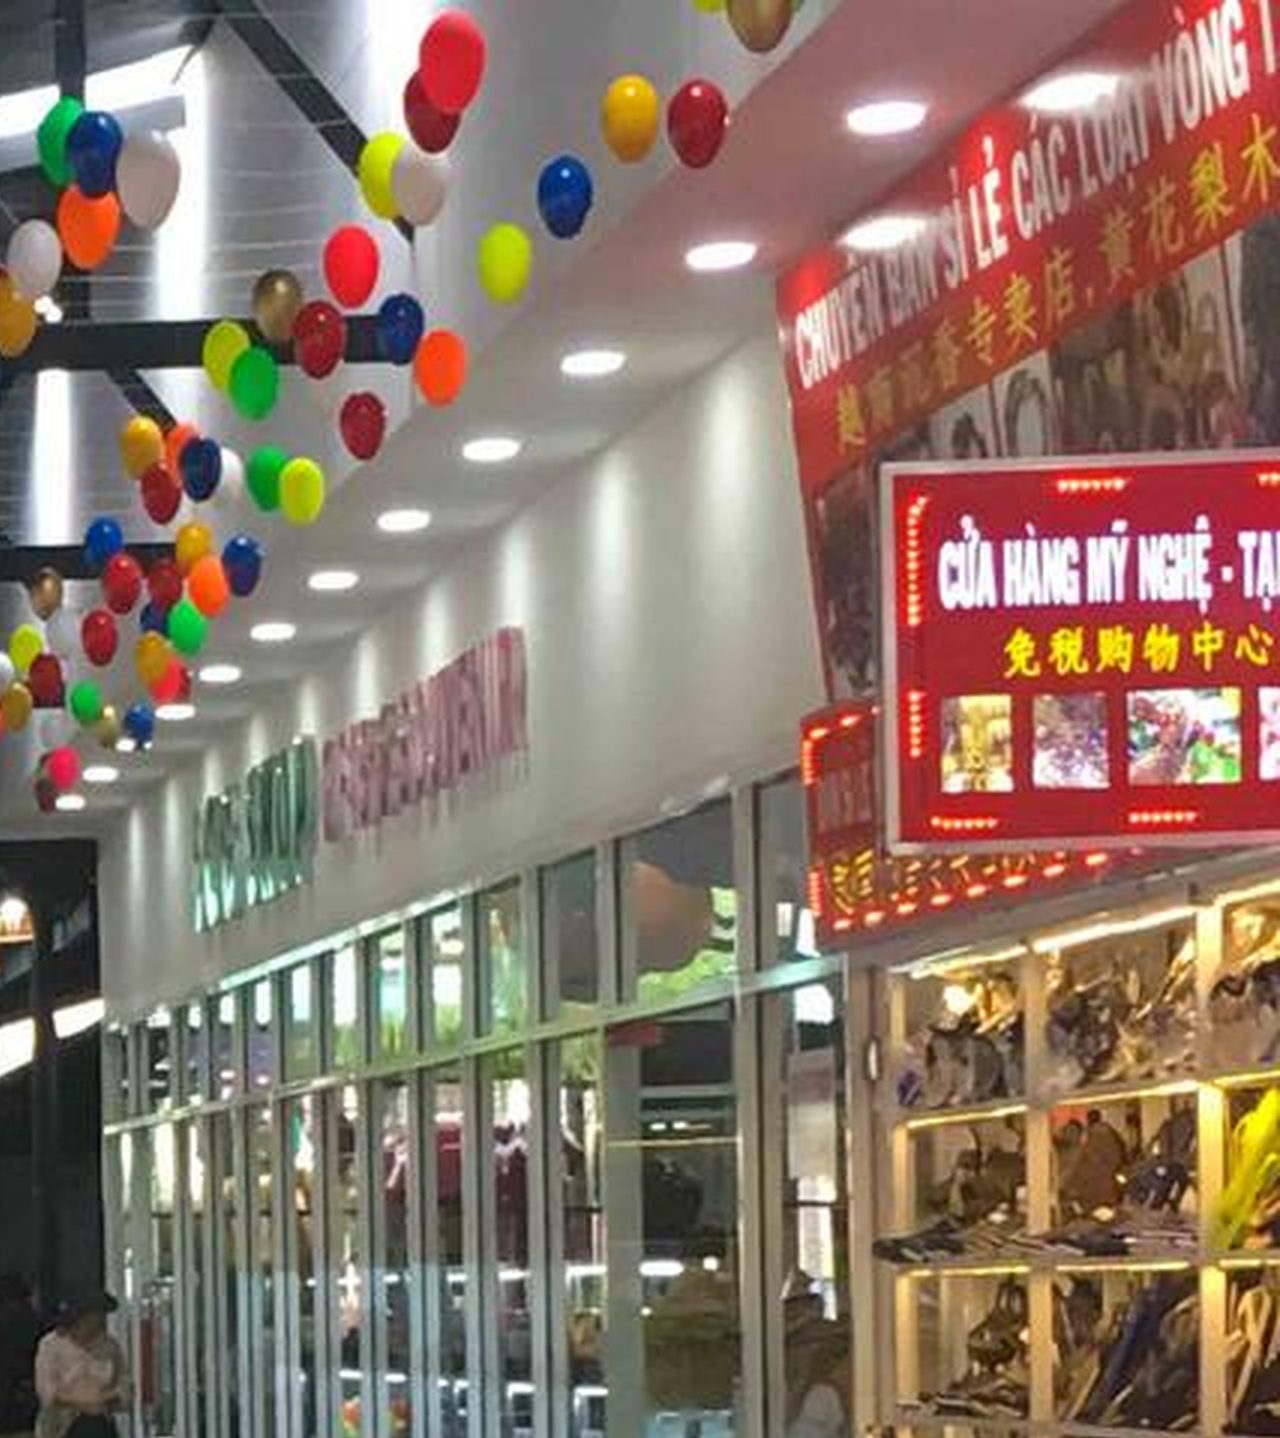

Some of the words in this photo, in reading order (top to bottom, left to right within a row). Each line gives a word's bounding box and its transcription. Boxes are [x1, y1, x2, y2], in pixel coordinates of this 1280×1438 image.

[1011, 112, 1071, 240] CÁC
[1151, 0, 1250, 145] VÒNG
[939, 514, 997, 610] CỬA
[1002, 521, 1080, 607] HÀNG
[1086, 519, 1129, 603] MỸ
[1138, 514, 1213, 614] NGHỆ
[1003, 620, 1274, 679] 免税购物中心
